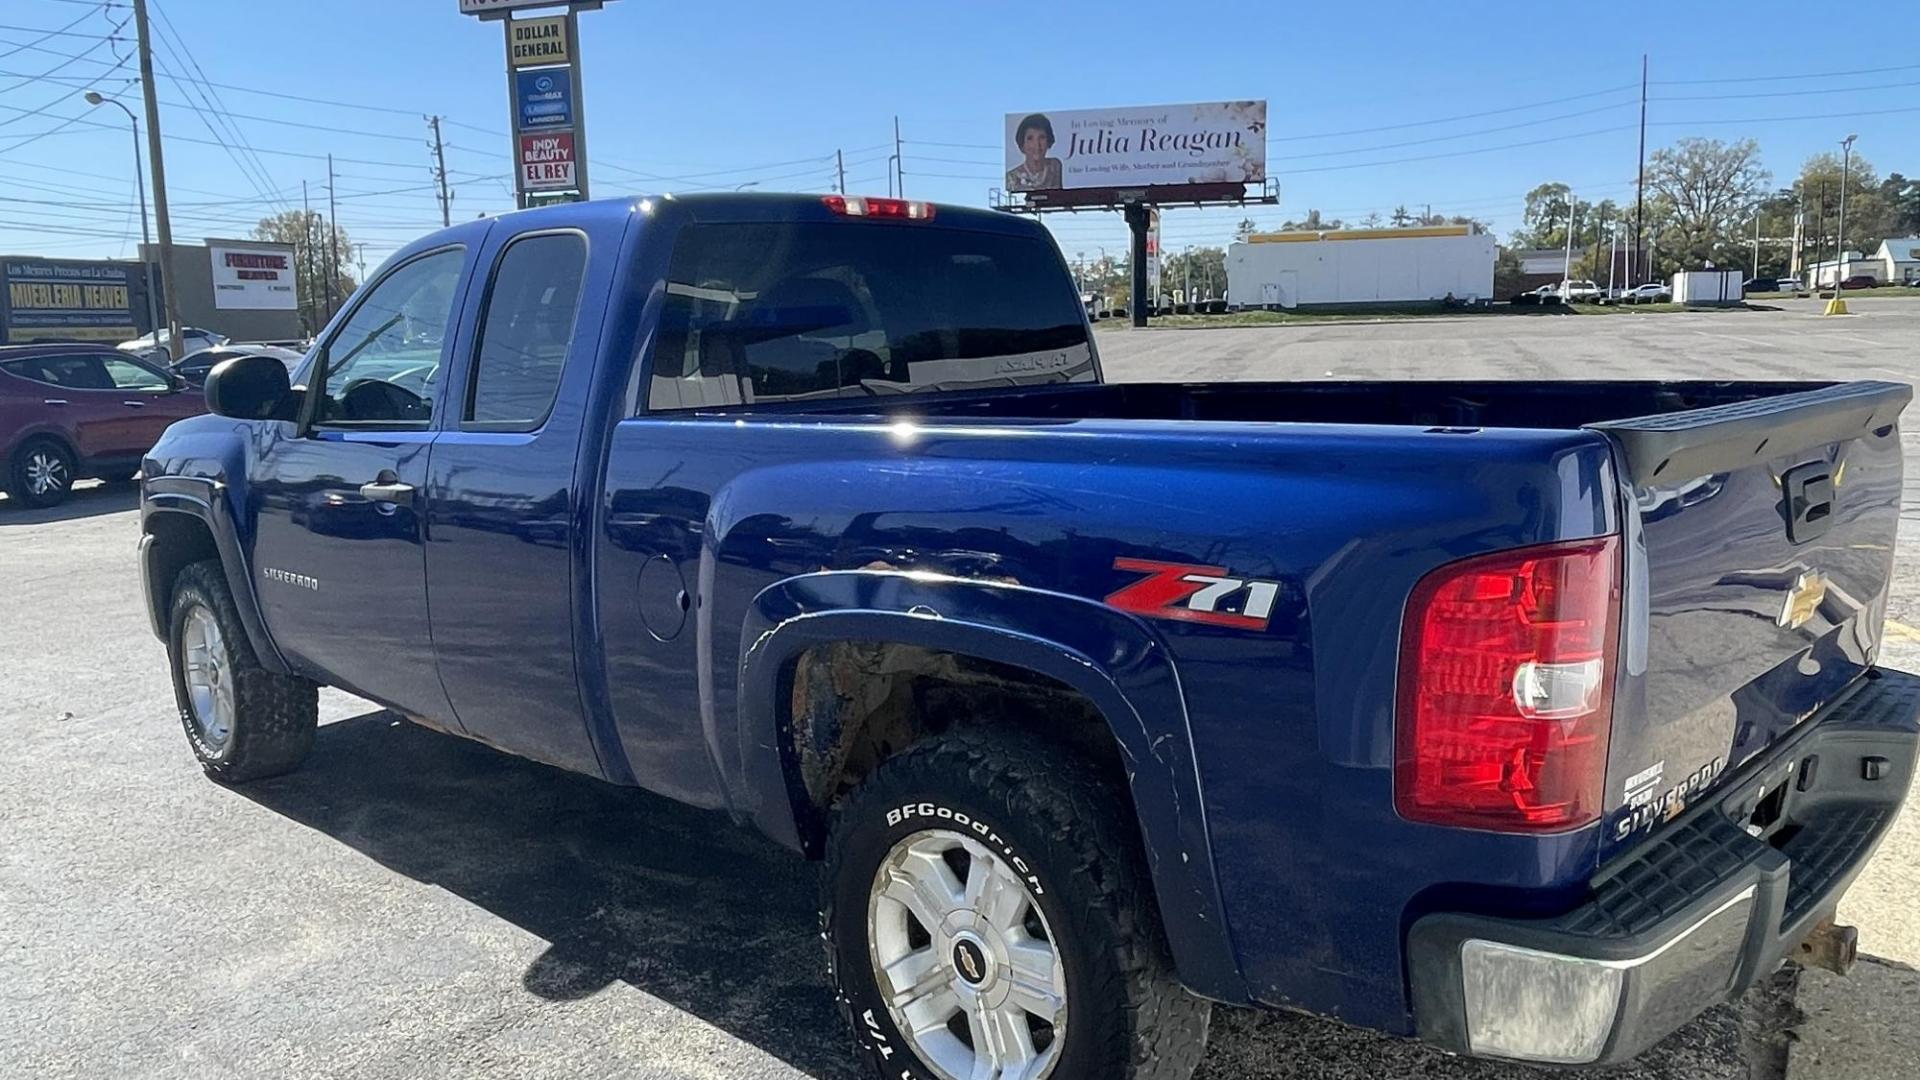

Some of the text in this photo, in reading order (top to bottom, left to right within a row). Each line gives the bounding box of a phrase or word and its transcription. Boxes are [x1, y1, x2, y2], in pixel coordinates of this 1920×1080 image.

[516, 24, 559, 41] DOLLAR
[514, 42, 564, 58] GENERAL
[1071, 114, 1168, 129] In Loving Memory of
[532, 139, 560, 150] INDY
[1066, 128, 1241, 160] Julia Reagan
[525, 149, 569, 162] BEAUTY
[527, 162, 570, 180] EL REY
[7, 263, 22, 275] Los
[92, 267, 101, 278] La
[10, 283, 129, 309] MUEBLERIA HEAVEN
[263, 567, 318, 591] SILVERADO
[1104, 556, 1281, 632] Z71
[886, 803, 1044, 895] BFGoodrich
[862, 1009, 894, 1061] T/A
